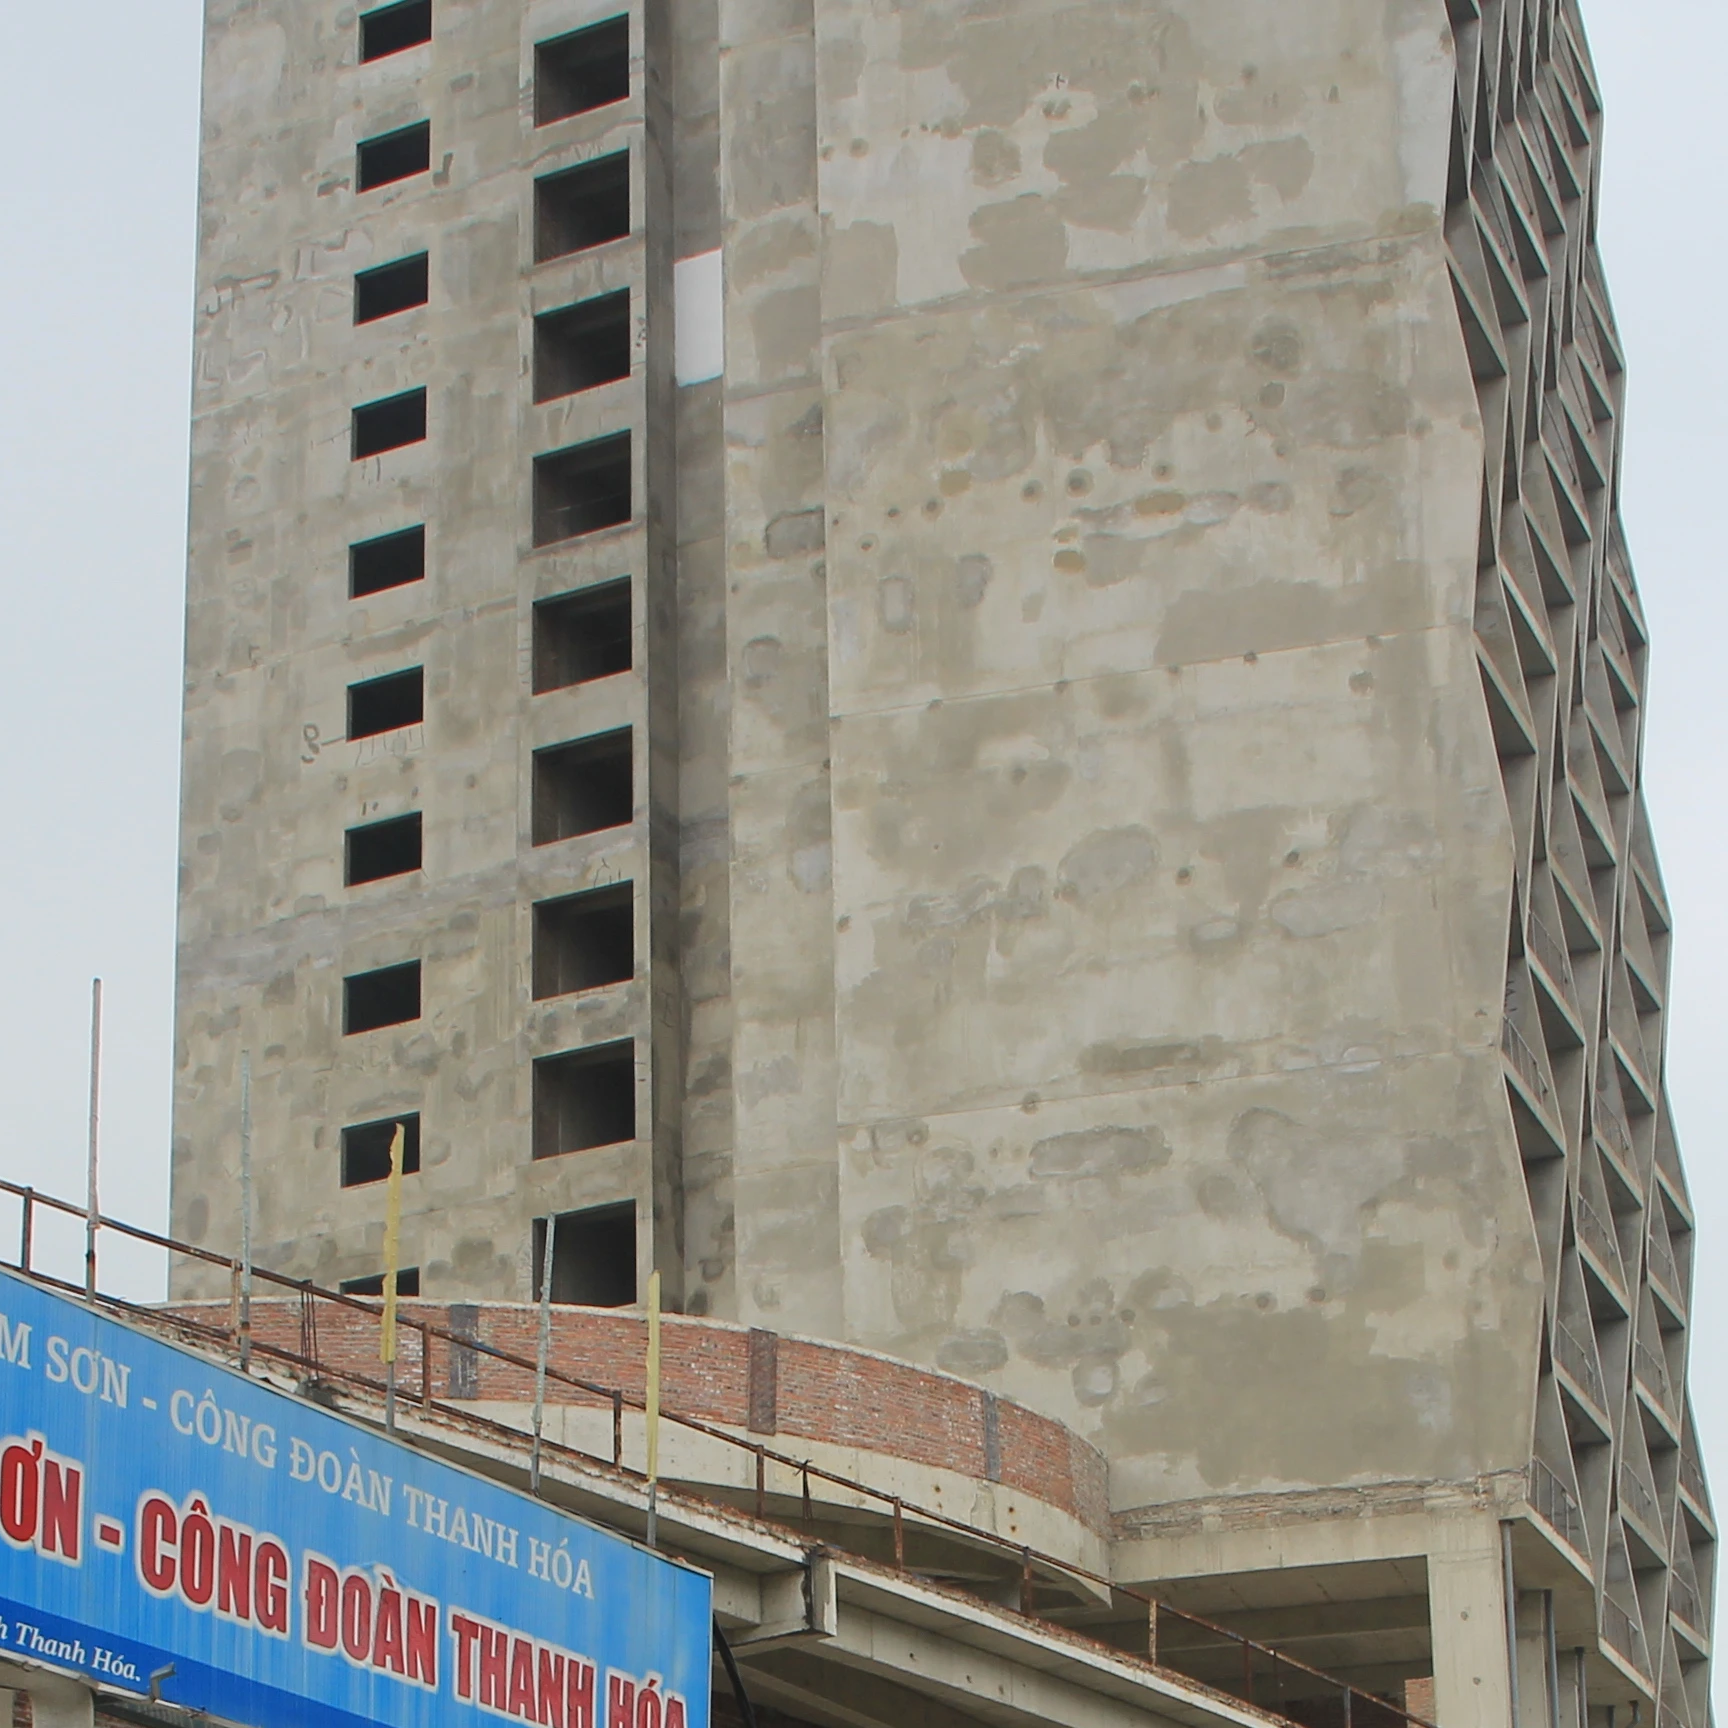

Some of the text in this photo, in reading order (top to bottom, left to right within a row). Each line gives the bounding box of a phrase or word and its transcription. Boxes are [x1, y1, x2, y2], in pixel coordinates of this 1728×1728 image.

[46, 1336, 130, 1409] SƠN
[170, 1388, 277, 1468] CÔNG
[289, 1436, 391, 1516] ĐOÀN
[403, 1487, 518, 1566] THANH
[528, 1536, 596, 1600] HÓA
[14, 1622, 87, 1666] Thanh
[93, 1643, 141, 1683] Hóa.
[142, 1492, 287, 1631] CÔNG
[305, 1559, 437, 1686] ĐOÀN
